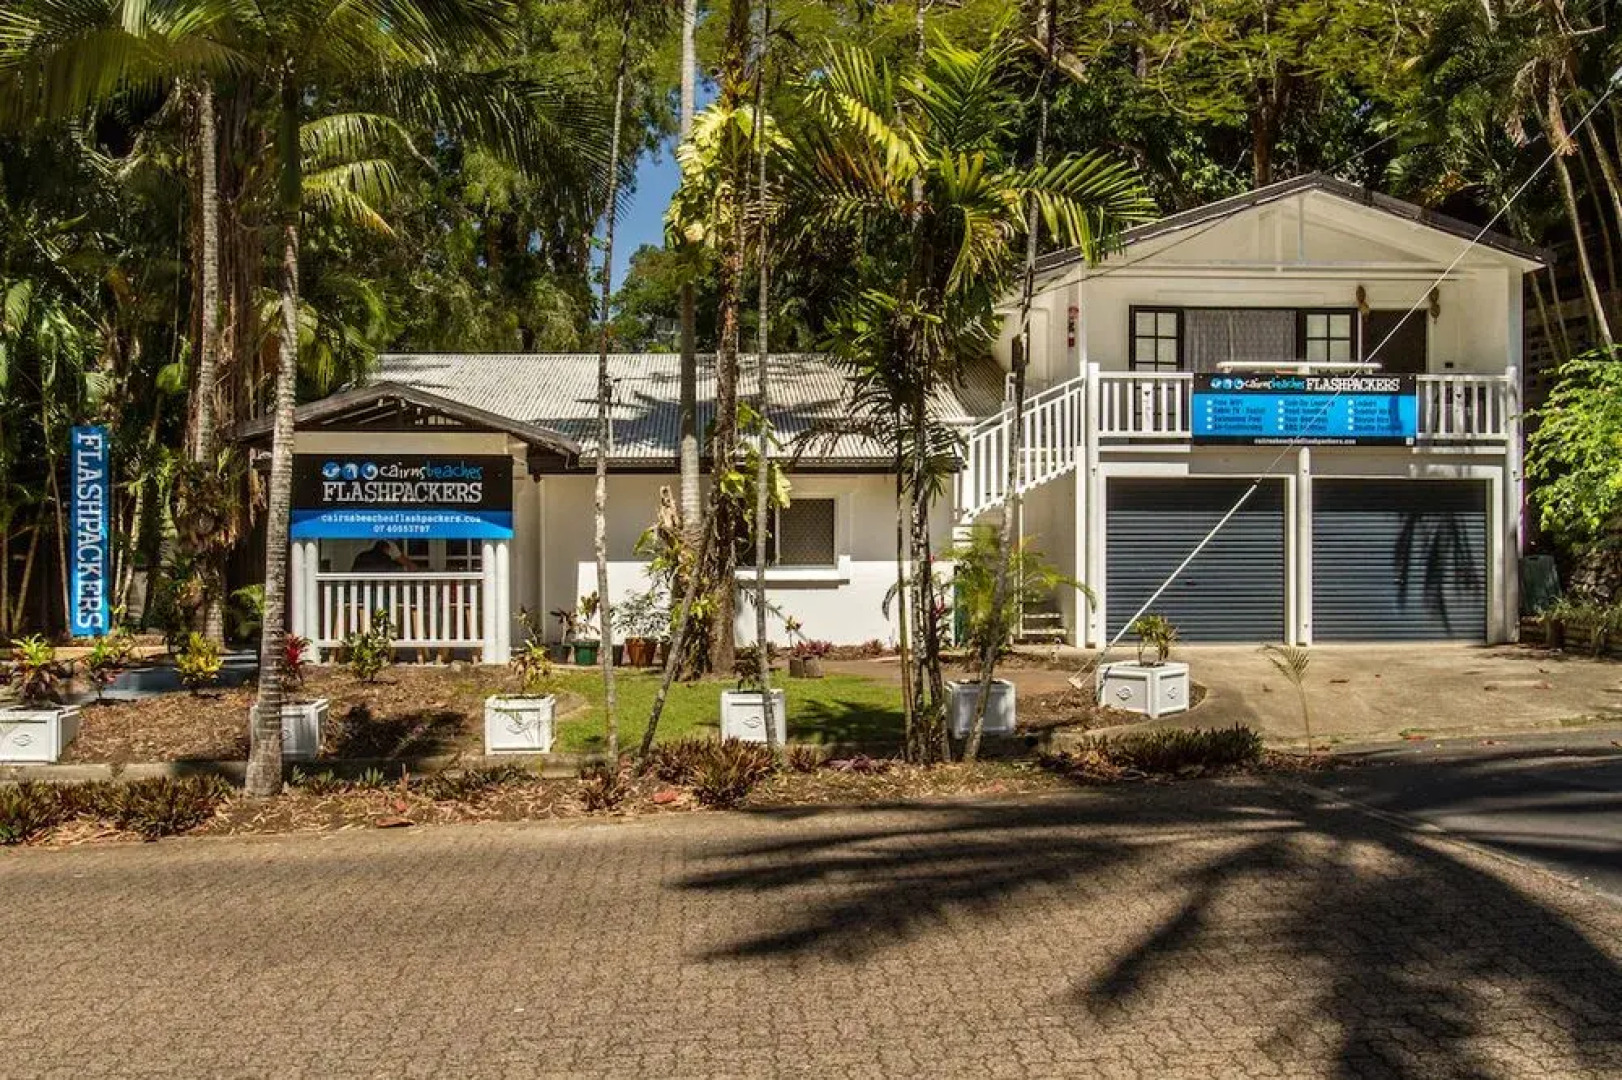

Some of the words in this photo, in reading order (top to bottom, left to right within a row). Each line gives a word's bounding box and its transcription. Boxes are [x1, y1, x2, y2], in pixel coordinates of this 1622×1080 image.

[1306, 378, 1400, 391] FLASHPACKERS
[322, 481, 483, 503] FLASHPACKERS
[77, 432, 103, 629] FLASHPACKERS
